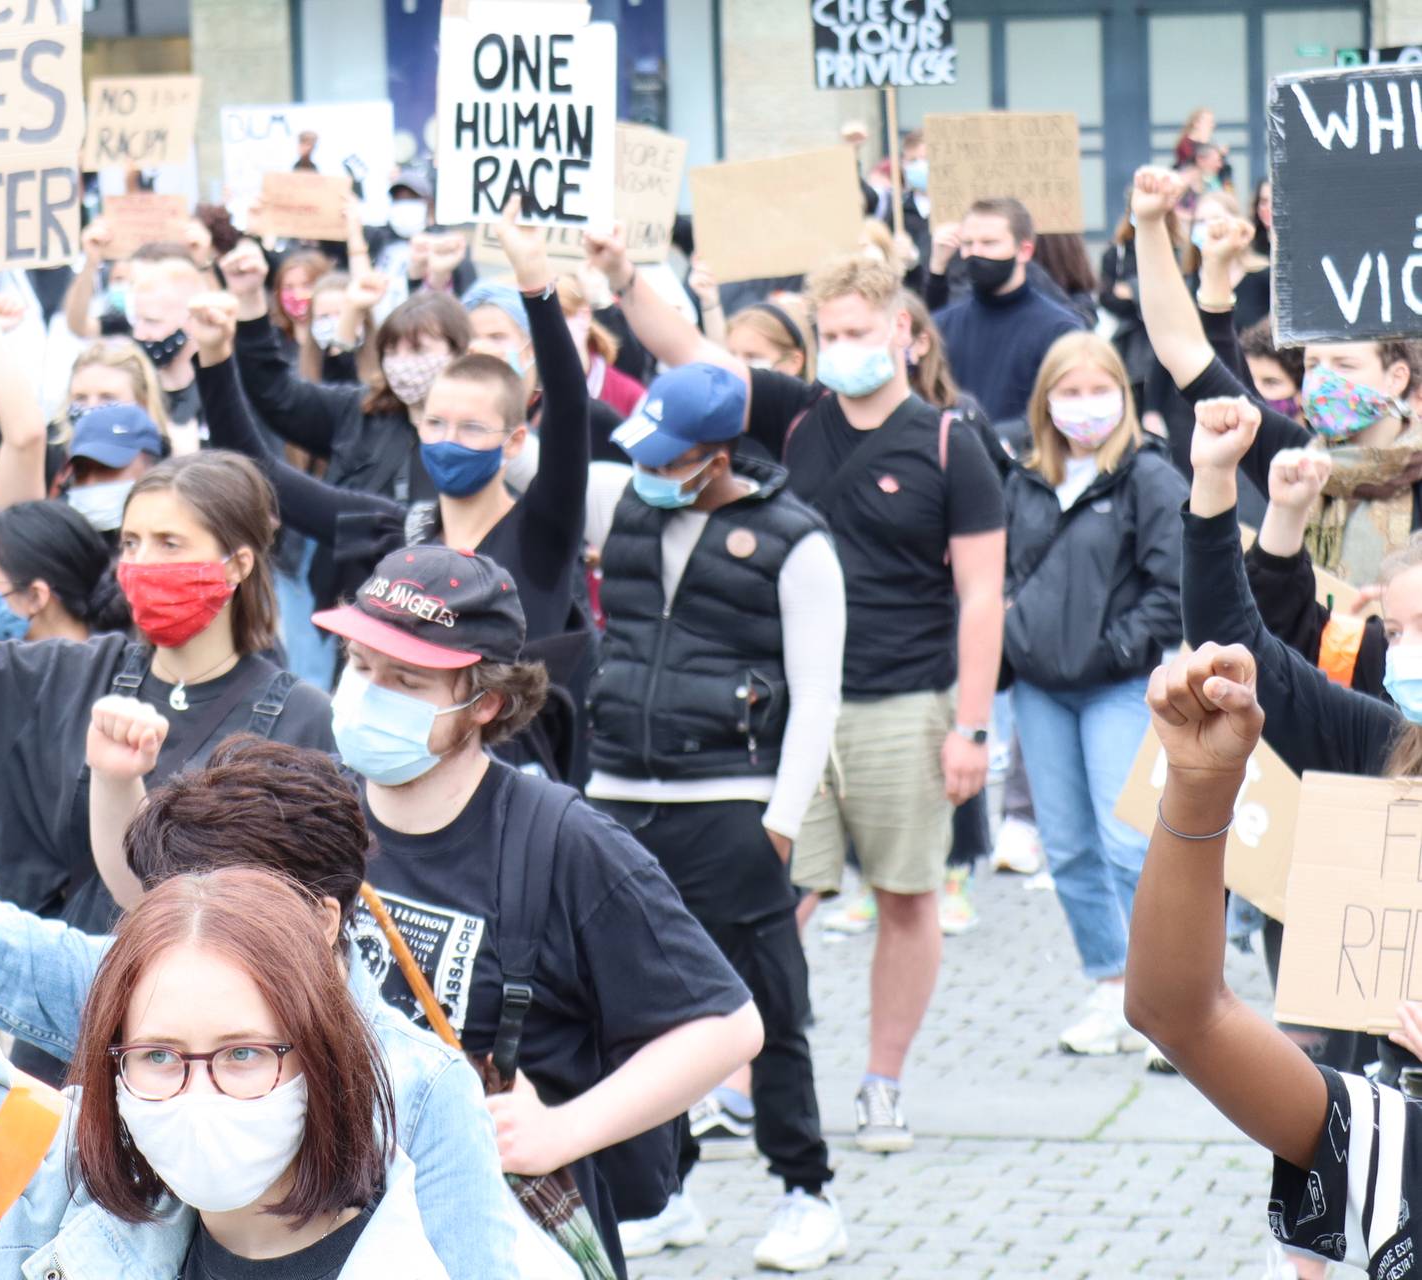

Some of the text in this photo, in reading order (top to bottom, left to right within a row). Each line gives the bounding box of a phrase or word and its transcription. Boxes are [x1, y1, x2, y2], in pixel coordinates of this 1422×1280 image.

[830, 18, 944, 54] YOUR
[473, 33, 575, 92] ONE
[97, 87, 138, 116] NO
[455, 102, 593, 158] HUMAN
[472, 155, 590, 222] RACE
[386, 585, 459, 628] ANGELES
